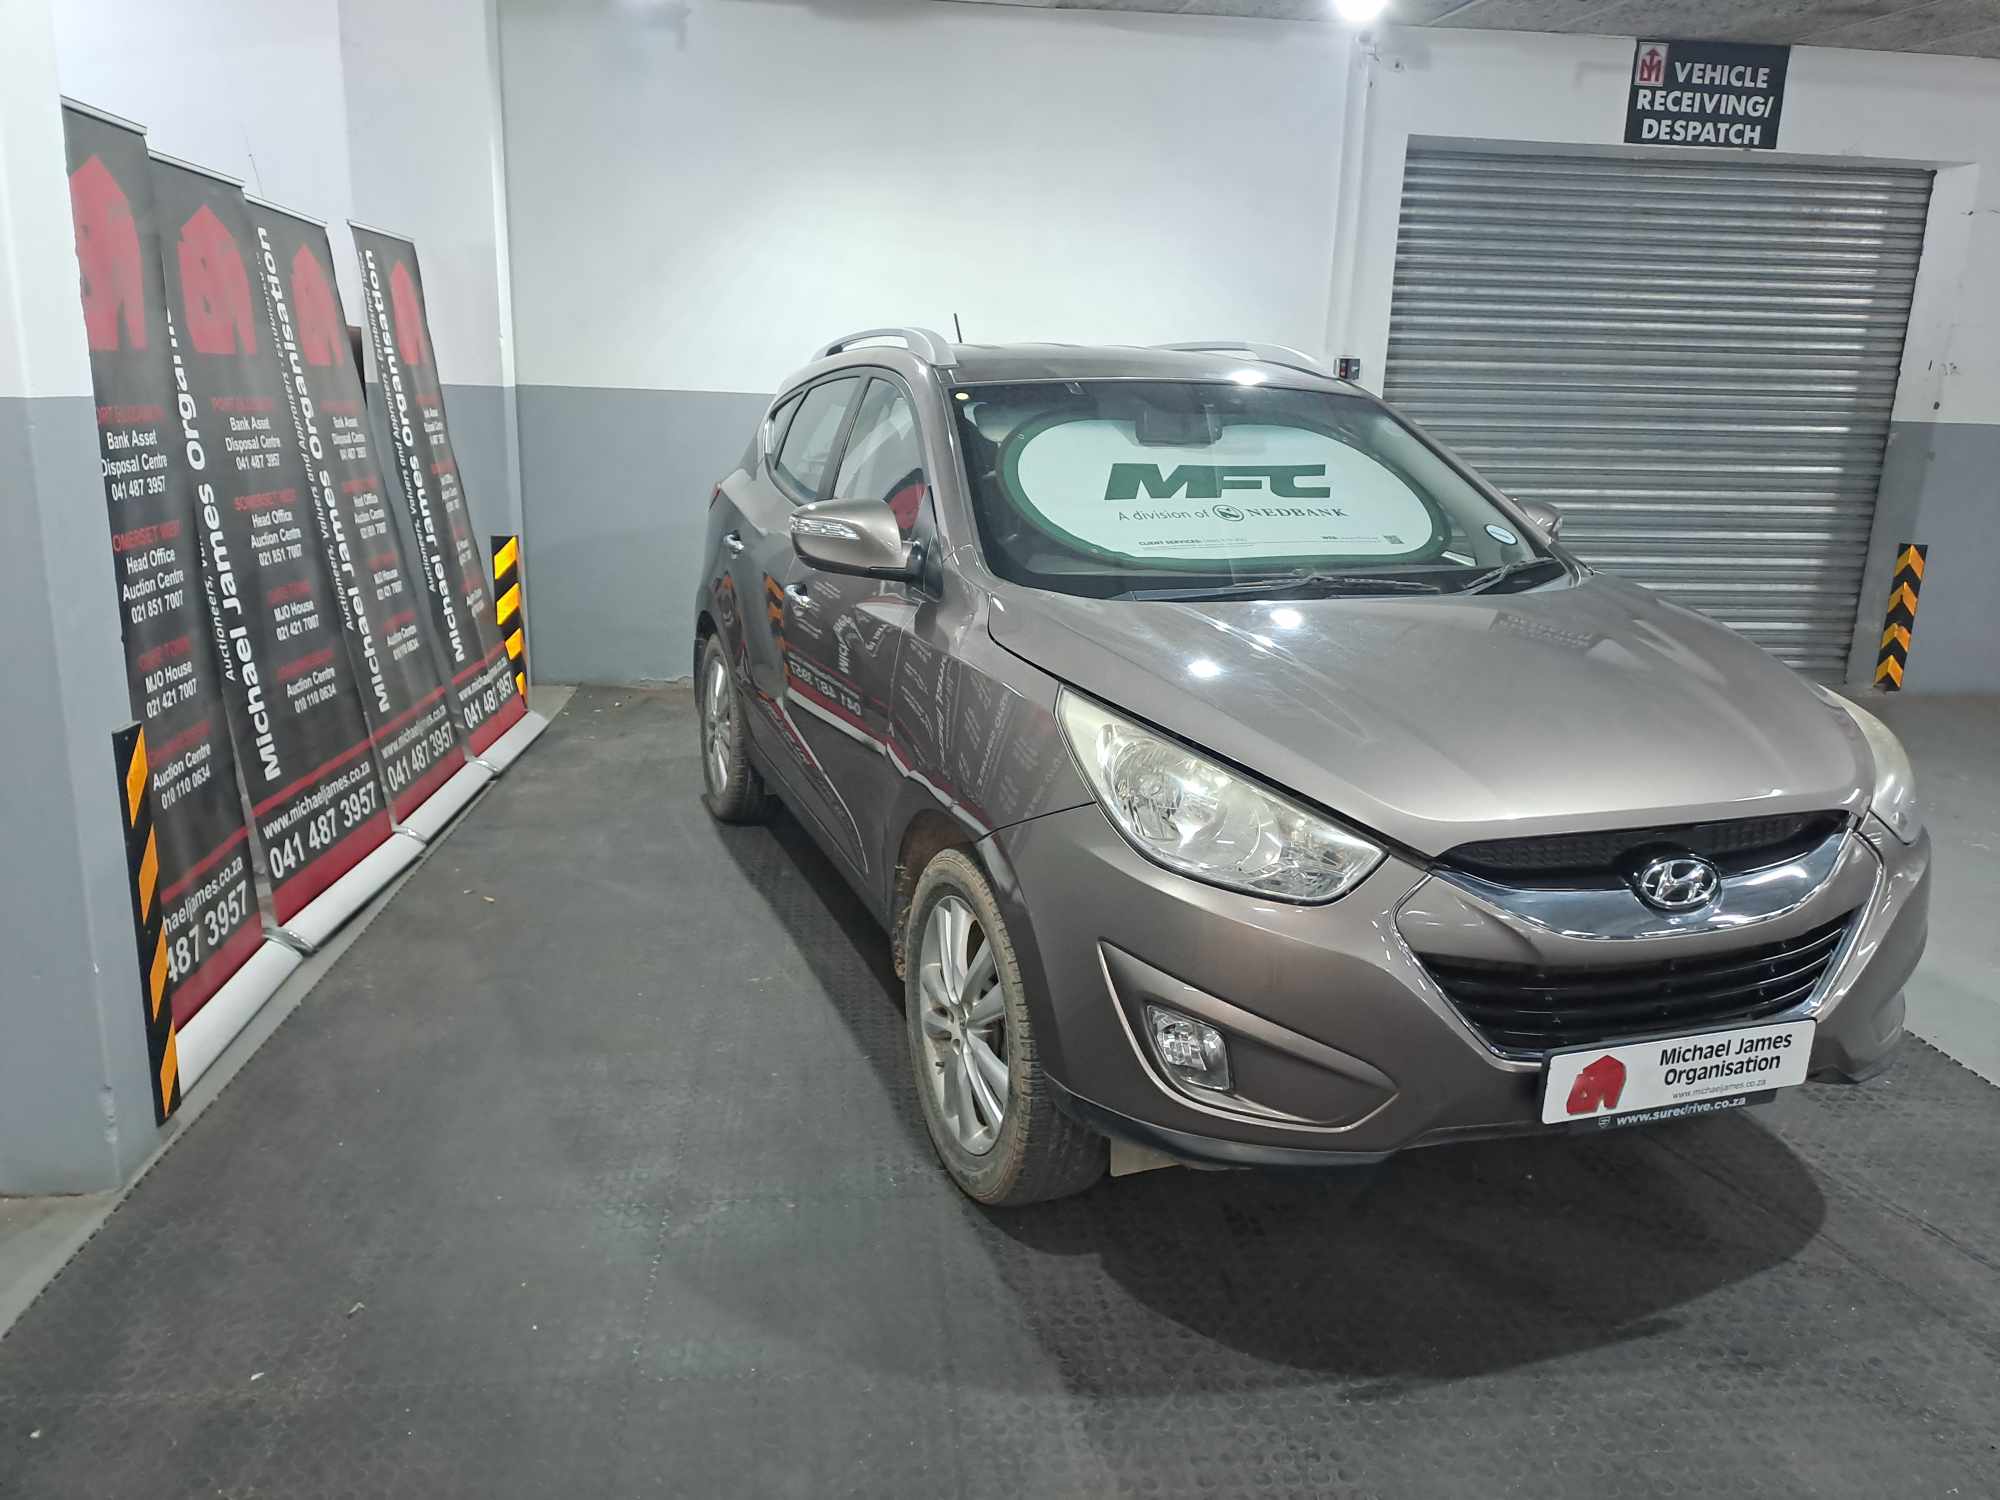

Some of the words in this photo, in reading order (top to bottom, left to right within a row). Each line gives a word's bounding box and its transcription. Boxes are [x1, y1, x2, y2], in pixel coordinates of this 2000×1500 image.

[1674, 61, 1770, 89] VEHICLE
[1636, 89, 1775, 118] RECEIVING/
[1641, 118, 1762, 146] DESPATCH
[257, 226, 323, 460] Organisation
[365, 250, 414, 447] Organisation
[106, 431, 130, 450] Bank
[131, 429, 158, 448] Asset
[141, 452, 168, 471] Centre
[111, 481, 127, 501] 041
[129, 479, 144, 498] 487
[147, 475, 166, 495] 3957
[1104, 462, 1331, 500] MFC
[410, 455, 438, 547] James
[1118, 511, 1131, 522] A
[1132, 508, 1191, 521] division
[1195, 508, 1211, 519] of
[1247, 507, 1350, 518] NEDBANK
[318, 469, 355, 577] James
[126, 552, 149, 575] Head
[149, 547, 176, 567] Office
[199, 483, 242, 615] James
[123, 579, 157, 602] Auction
[131, 602, 147, 624] 021
[147, 597, 163, 618] 851
[431, 554, 465, 663] Michael
[347, 586, 391, 713] Michael
[145, 672, 165, 695] MJO
[164, 660, 193, 684] House
[146, 697, 161, 719] 021
[162, 687, 179, 710] 421
[229, 626, 282, 782] Michael
[463, 703, 484, 729] 041
[497, 671, 514, 701] 3957
[387, 755, 412, 792] 041
[411, 742, 431, 773] 487
[429, 721, 454, 758] 3957
[153, 758, 185, 791] Auction
[263, 761, 371, 840] www.michaeljames.co.za
[269, 831, 305, 879] 041
[309, 807, 337, 849] 487
[340, 780, 376, 828] 3957
[163, 855, 244, 936] haeljames.co.za
[204, 879, 248, 946] 3957
[1659, 1038, 1731, 1067] Michael
[1734, 1032, 1792, 1056] James
[1664, 1054, 1781, 1086] Organisation
[1616, 1096, 1747, 1127] www.suredrive.co.za
